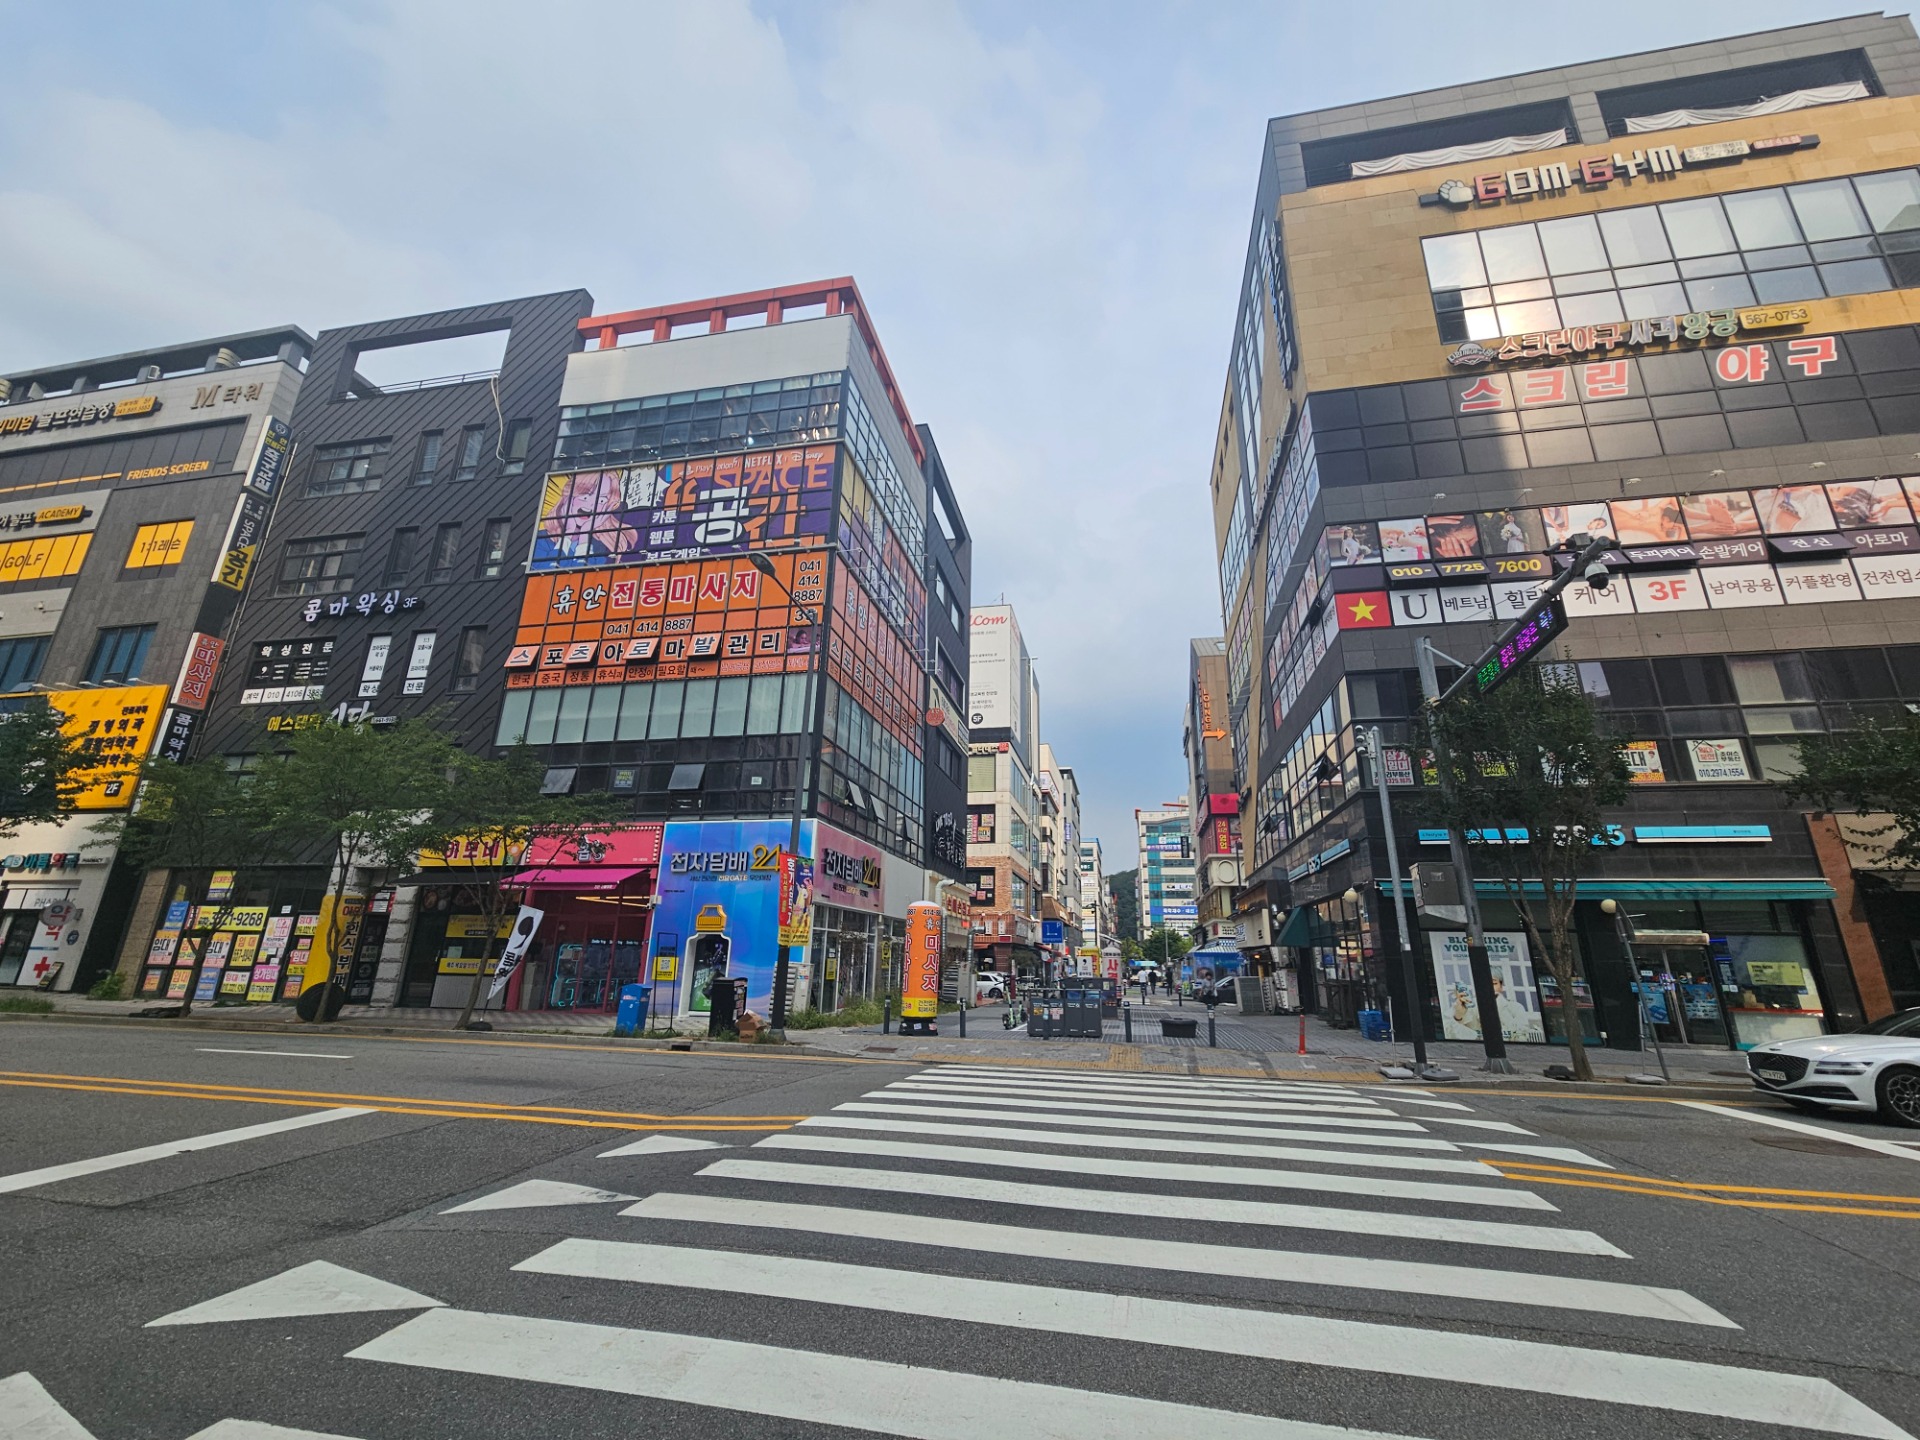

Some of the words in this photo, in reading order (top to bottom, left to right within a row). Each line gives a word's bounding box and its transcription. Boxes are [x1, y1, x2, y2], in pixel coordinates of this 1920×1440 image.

[1474, 162, 1572, 201] GOM
[1579, 144, 1683, 185] GYM
[1745, 307, 1808, 326] 567-0753
[1498, 325, 1623, 361] 스크린야구
[1628, 316, 1678, 346] 사격
[1682, 309, 1738, 341] 양궁
[1460, 360, 1630, 412] 스크린
[1716, 335, 1839, 382] 야구
[191, 383, 222, 410] M
[223, 382, 264, 404] 타워
[126, 466, 168, 481] FRIENDS
[169, 460, 209, 476] SCREEN
[38, 507, 80, 520] ACADEMY
[652, 510, 678, 524] 카툰
[691, 486, 826, 549] 공간
[236, 519, 255, 549] SPACE
[650, 530, 675, 545] 웹툰
[1630, 546, 1696, 560] 두피케어
[1699, 541, 1766, 560] 손발케어
[1791, 536, 1834, 548] 전신
[1854, 532, 1910, 549] 아로마
[4, 553, 45, 568] GOLF
[221, 549, 249, 587] 공간
[799, 560, 821, 572] 041
[1391, 567, 1432, 578] 010-
[1442, 563, 1486, 575] 7725
[1496, 558, 1542, 573] 7600
[552, 584, 607, 615] 휴안
[611, 569, 760, 609] 전통마사지
[798, 575, 820, 588] 414
[1647, 579, 1688, 601] 3F
[1709, 576, 1776, 596] 남여공용
[1785, 572, 1852, 590] 커플환영
[402, 597, 418, 609] 3F
[793, 589, 823, 602] 8887
[1400, 594, 1428, 619] U
[1443, 596, 1491, 611] 베트남
[1573, 583, 1620, 605] 케어
[606, 623, 629, 636] 041
[636, 621, 659, 634] 414
[664, 618, 692, 632] 8887
[509, 645, 590, 667] 스포츠
[604, 638, 686, 662] 아로마
[694, 631, 782, 655] 발관리
[183, 647, 217, 698] 마사지
[511, 674, 531, 685] 한국
[541, 672, 561, 684] 중국
[569, 671, 589, 682] 정통
[598, 669, 622, 681] 휴식과
[628, 666, 653, 679] 안정이
[658, 664, 686, 677] 필요할
[266, 691, 281, 700] 010
[285, 690, 303, 699] 4106
[105, 783, 120, 794] 2F
[671, 851, 748, 872] 전자담배
[750, 844, 781, 871] 24
[825, 849, 863, 882] 전자담배
[153, 938, 171, 951] 임대
[922, 935, 941, 993] 마사지
